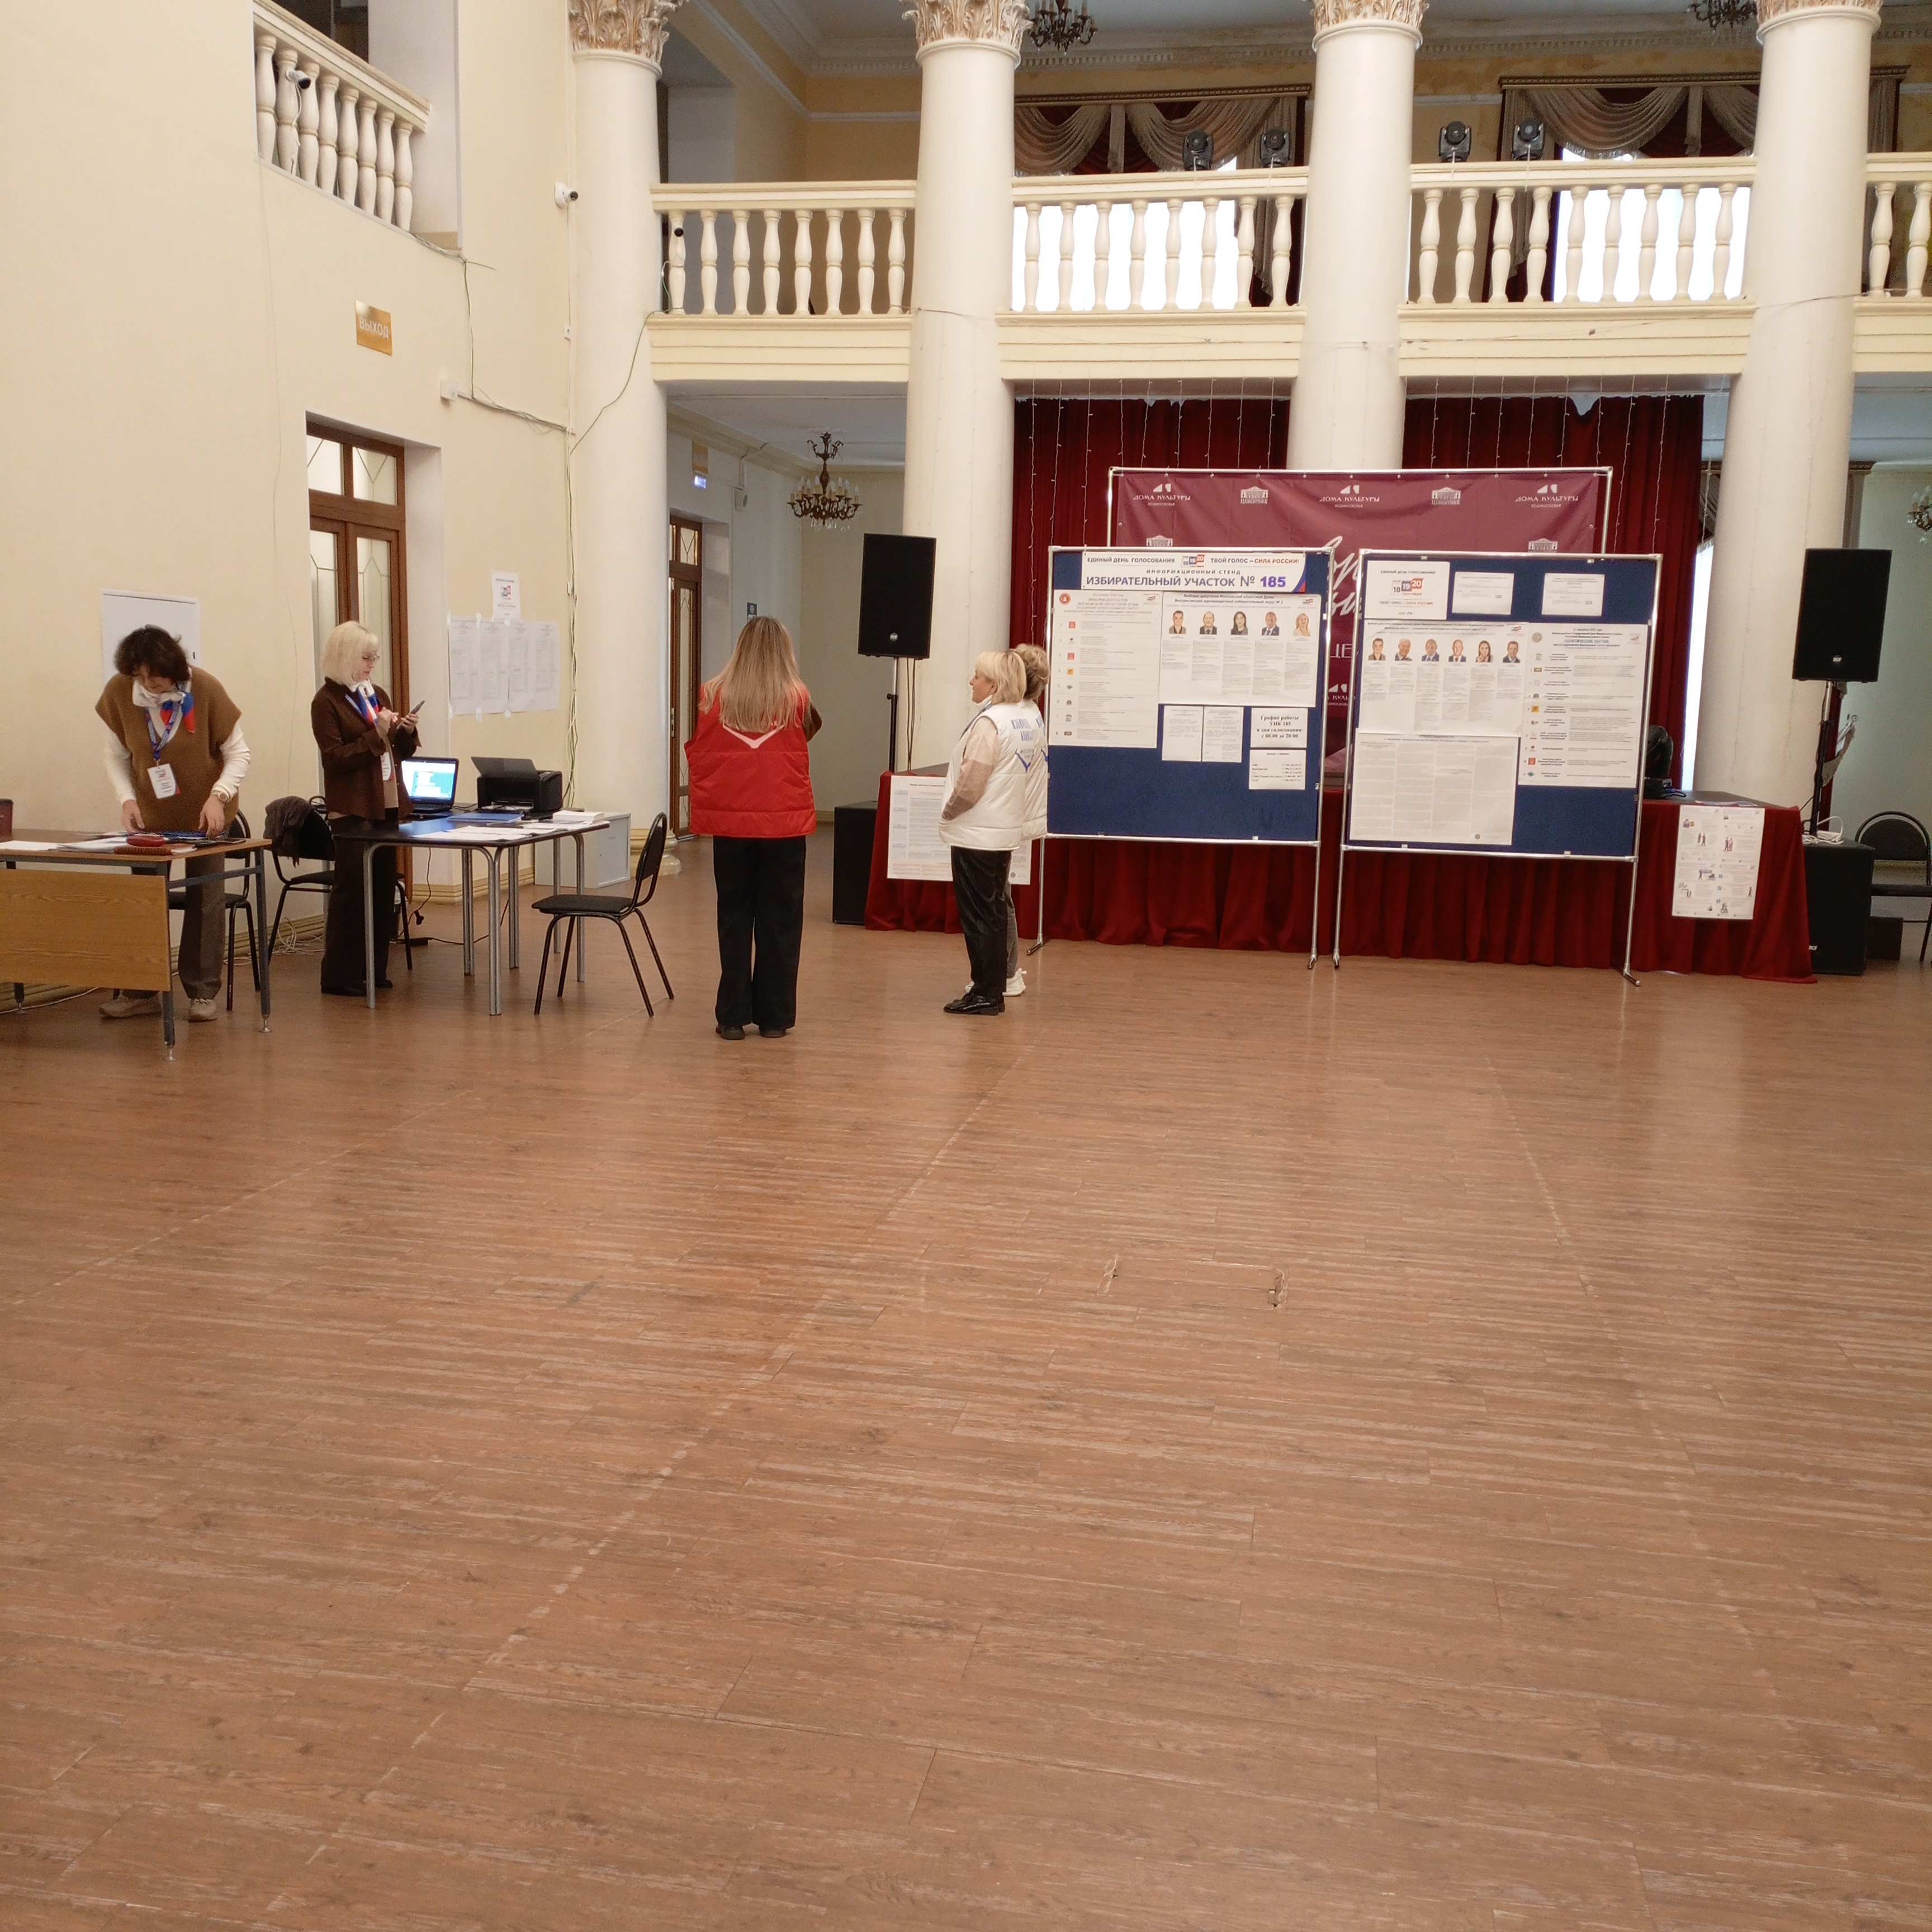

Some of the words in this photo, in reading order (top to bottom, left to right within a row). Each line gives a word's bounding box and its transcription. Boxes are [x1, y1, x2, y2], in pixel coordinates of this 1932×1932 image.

[359, 317, 389, 340] ВЫХОД
[1086, 576, 1181, 586] ИЗБИРАТЕЛЬНЫЙ
[1185, 577, 1235, 586] УЧАСТОК
[1240, 575, 1255, 587] №
[1260, 576, 1286, 588] 185
